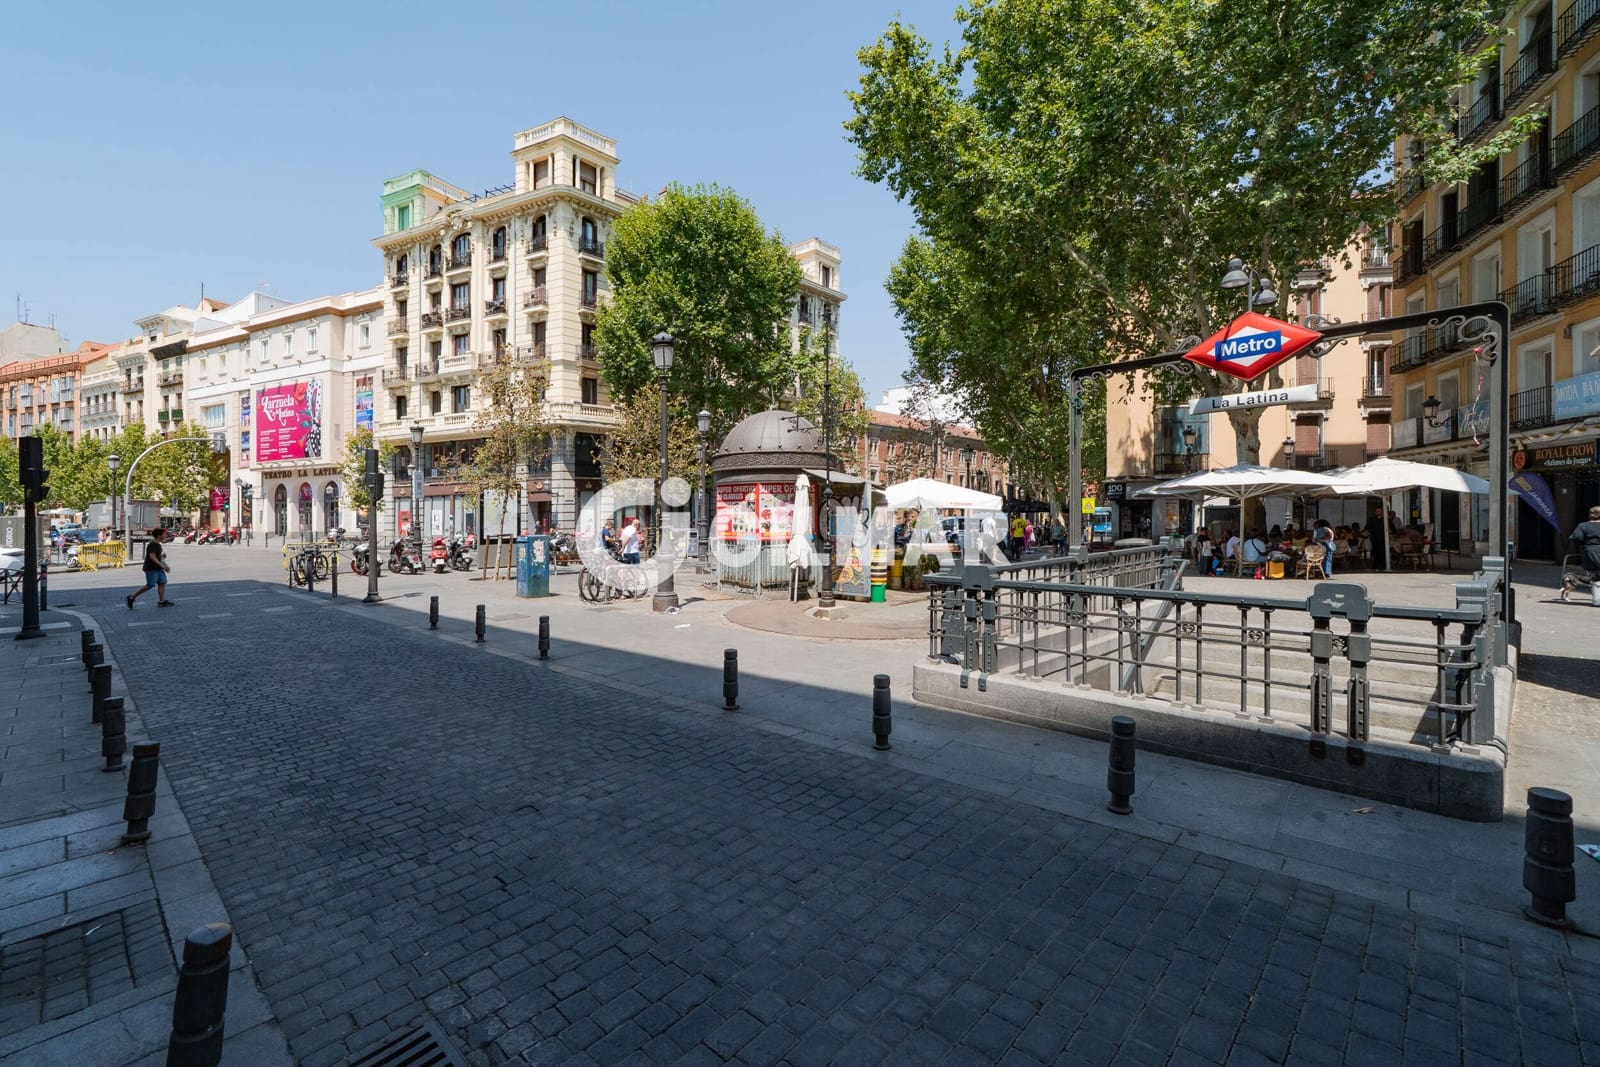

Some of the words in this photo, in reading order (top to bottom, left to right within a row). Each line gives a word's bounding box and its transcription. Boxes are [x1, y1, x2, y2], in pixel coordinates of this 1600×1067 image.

[1221, 338, 1276, 356] Metro
[1212, 399, 1229, 409] La
[1236, 392, 1288, 406] Latina
[1557, 384, 1579, 402] MODA
[1535, 446, 1564, 460] ROYAL
[264, 471, 292, 479] TEATRO
[298, 469, 308, 477] LA
[759, 485, 782, 493] SUPER
